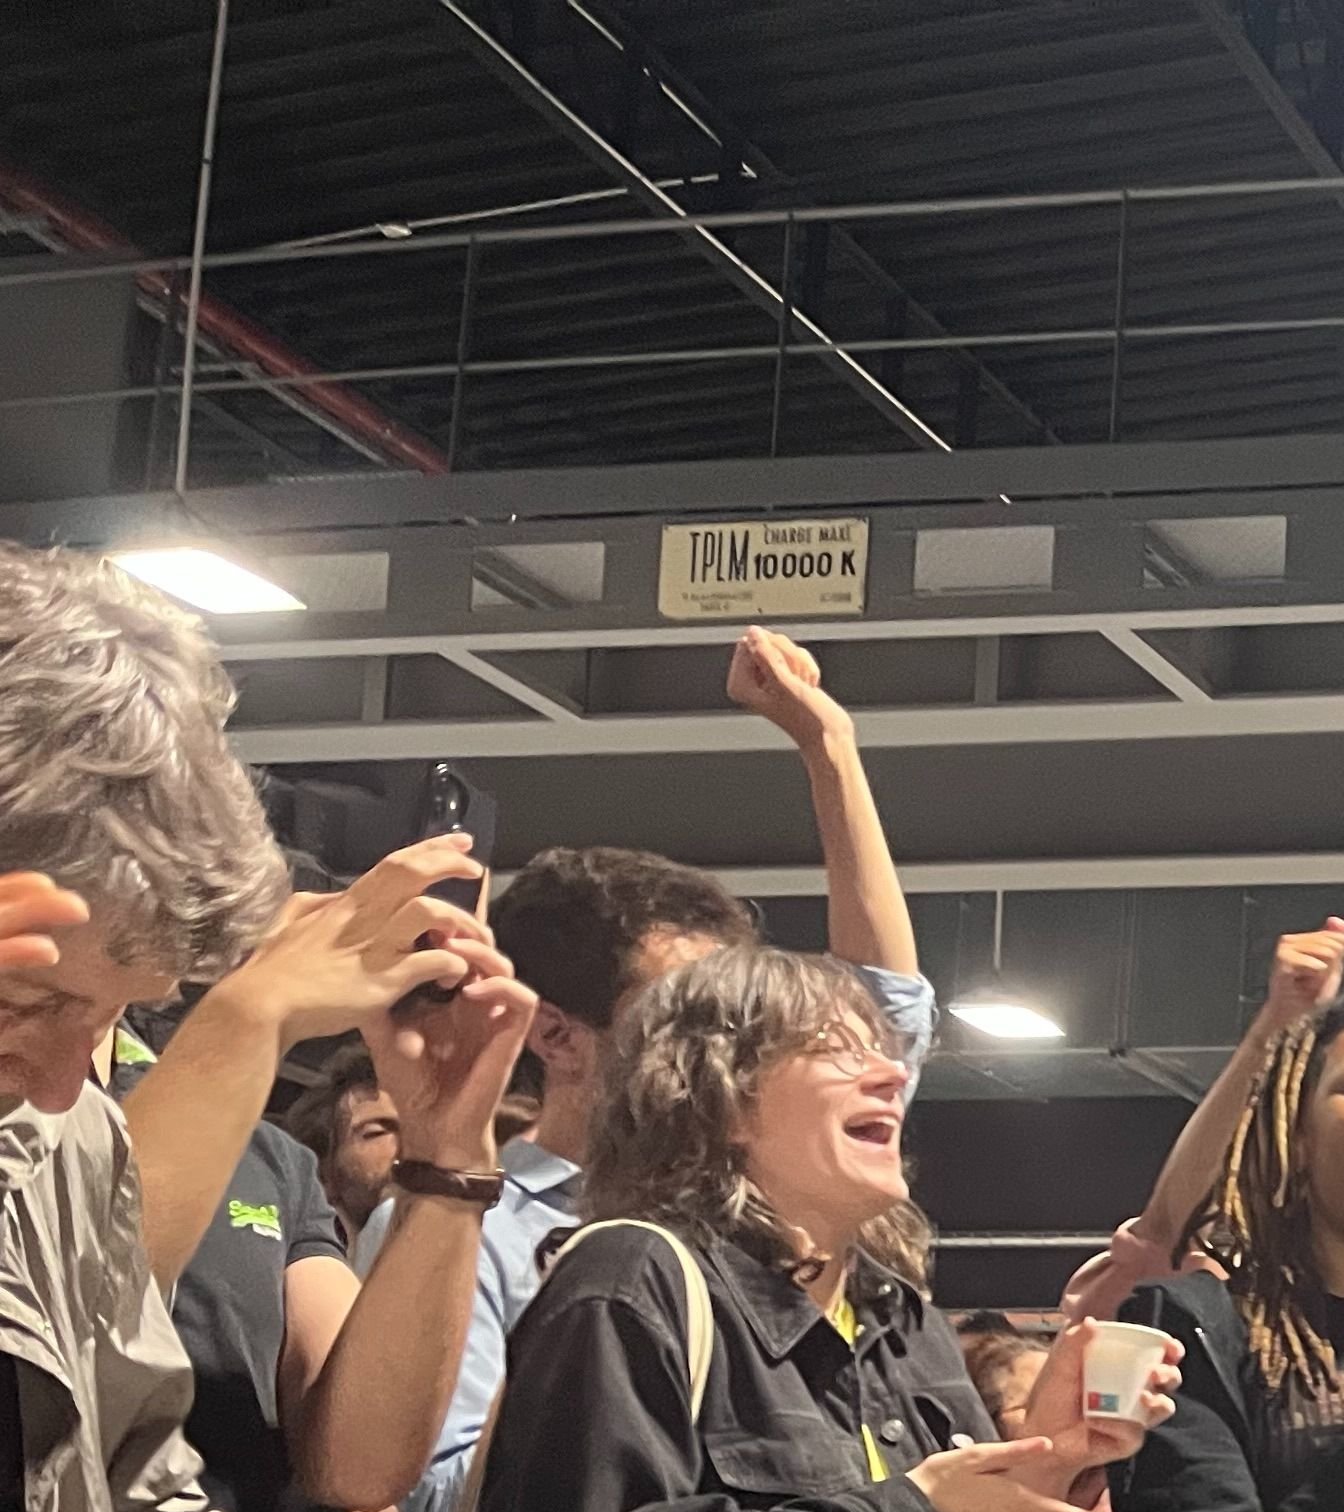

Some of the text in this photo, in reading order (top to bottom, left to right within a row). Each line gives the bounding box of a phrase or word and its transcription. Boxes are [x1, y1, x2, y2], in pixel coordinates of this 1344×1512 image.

[689, 530, 749, 583] TPLM
[754, 549, 855, 580] 10000 K
